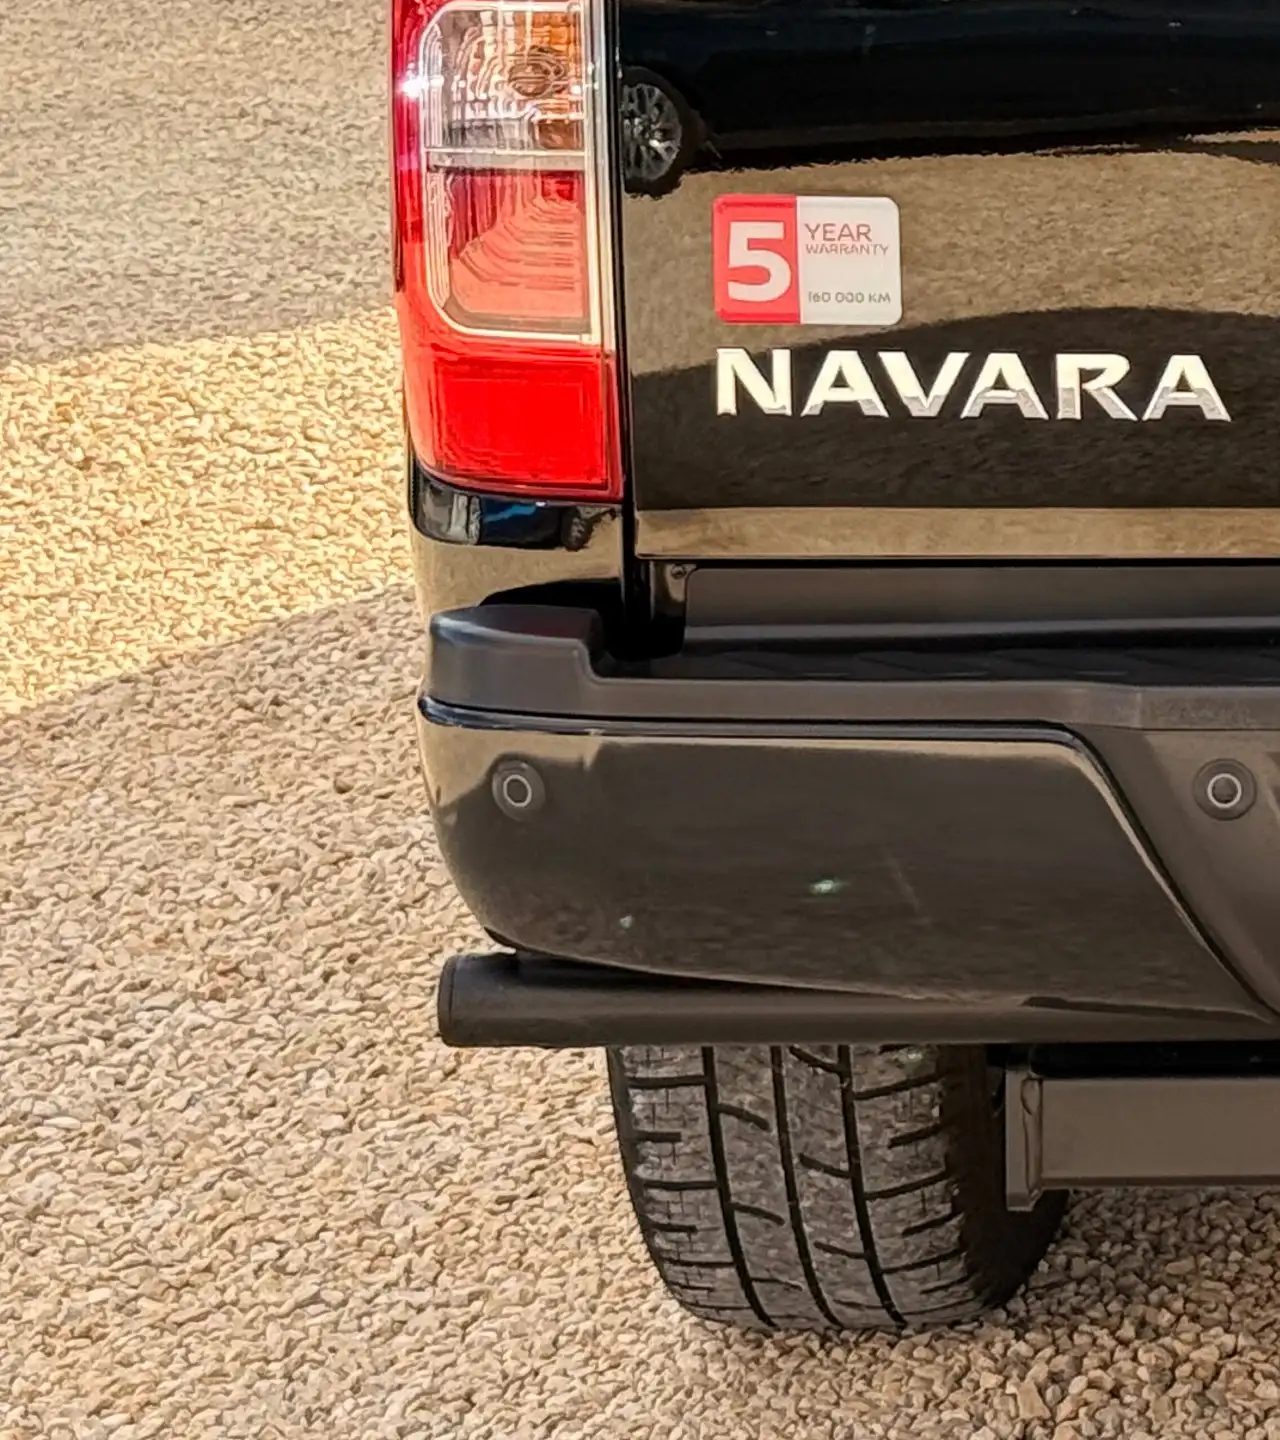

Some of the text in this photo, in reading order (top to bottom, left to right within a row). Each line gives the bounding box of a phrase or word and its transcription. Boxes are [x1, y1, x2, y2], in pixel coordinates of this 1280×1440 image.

[804, 223, 872, 242] YEAR
[805, 243, 889, 257] WARRANTY
[728, 221, 792, 302] 5
[808, 291, 891, 305] 160 000 KM
[716, 348, 1231, 422] NAVARA
